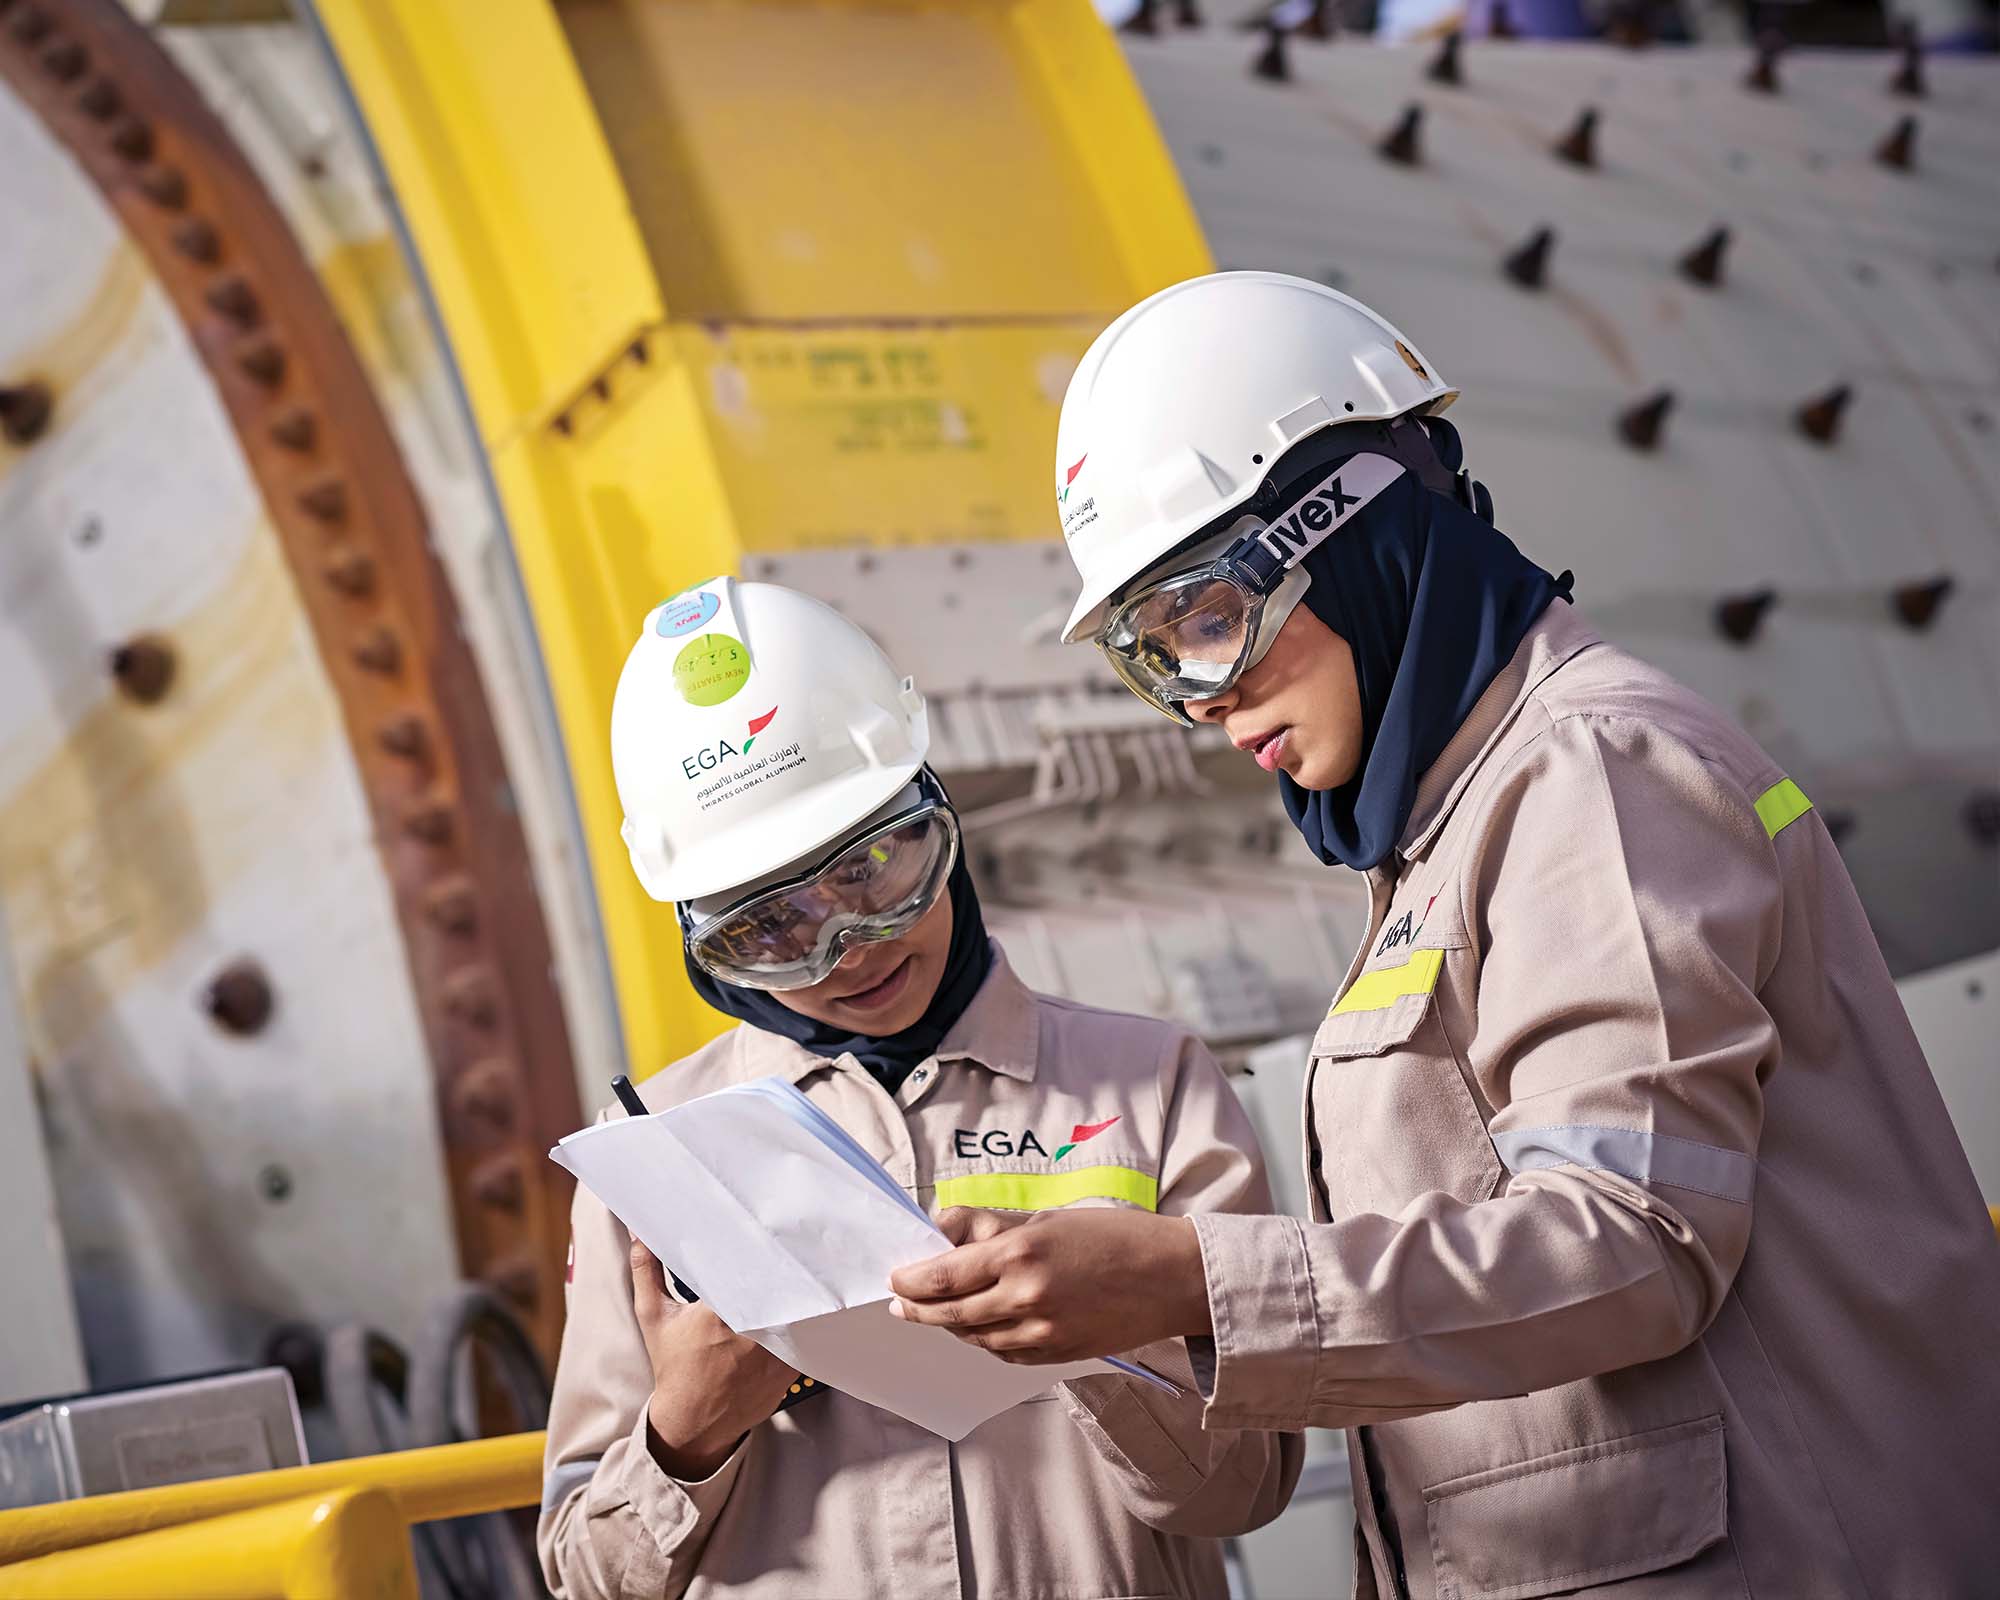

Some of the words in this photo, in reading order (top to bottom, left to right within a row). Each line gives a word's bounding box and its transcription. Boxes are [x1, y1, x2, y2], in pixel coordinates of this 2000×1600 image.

[1266, 476, 1361, 566] uvex
[682, 740, 738, 780] EGA
[769, 742, 801, 763] الإمارات
[701, 791, 735, 811] EMIRATES
[734, 777, 763, 795] GLOBAL
[765, 756, 807, 780] ALUMINIUM
[1375, 910, 1414, 958] EGA
[954, 1129, 1048, 1159] EGA
